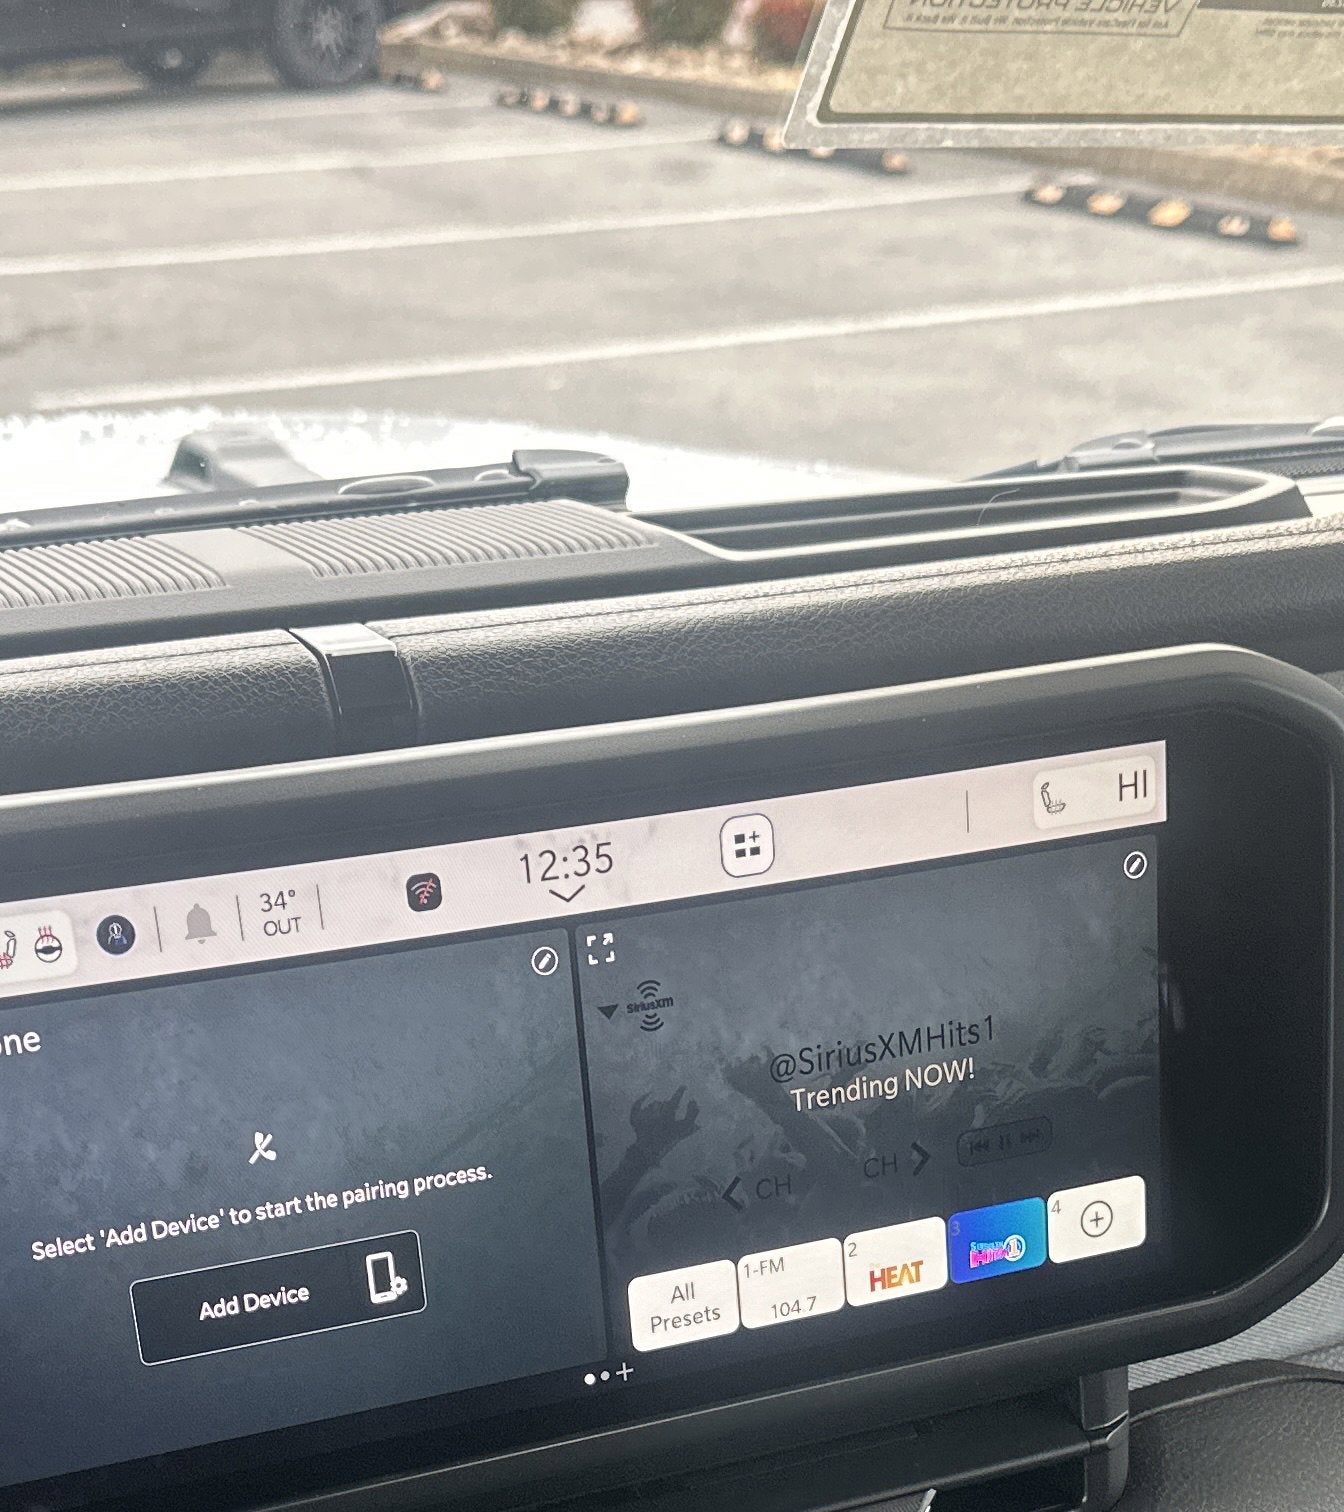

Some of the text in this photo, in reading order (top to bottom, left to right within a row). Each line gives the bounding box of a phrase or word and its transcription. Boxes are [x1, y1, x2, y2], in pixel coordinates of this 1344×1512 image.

[1118, 770, 1148, 803] HI
[519, 841, 614, 885] 12:35
[259, 888, 297, 914] 34°
[263, 915, 302, 938] OUT
[769, 1015, 995, 1084] @SiriusXMHits1
[790, 1057, 975, 1112] Trending NOW!
[863, 1153, 899, 1180] CH
[756, 1175, 793, 1200] CH
[32, 1166, 492, 1261] Select 'Add Device' to start the pairing process.
[1051, 1200, 1062, 1216] 4
[848, 1242, 858, 1258] 2
[743, 1256, 785, 1280] 1-FM
[869, 1261, 924, 1292] HEAT
[198, 1283, 310, 1321] Add Device
[671, 1282, 695, 1303] All
[650, 1304, 721, 1334] Presets
[771, 1296, 817, 1320] 104.7
